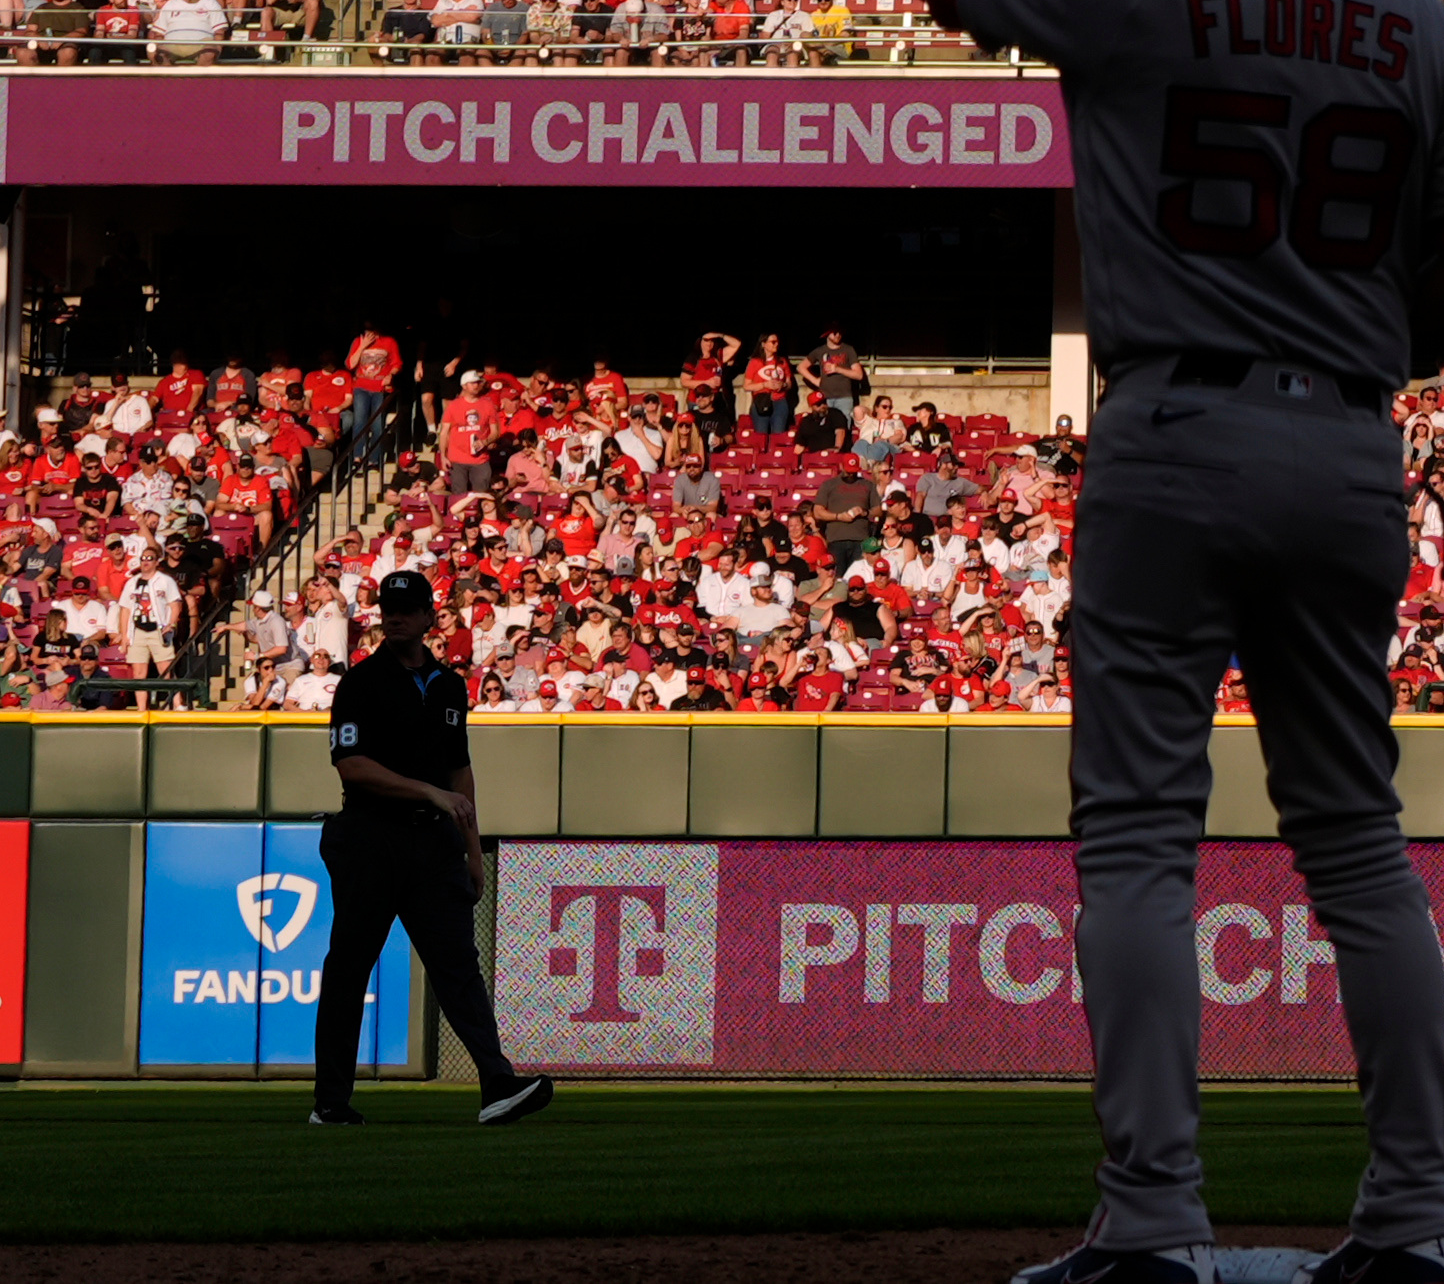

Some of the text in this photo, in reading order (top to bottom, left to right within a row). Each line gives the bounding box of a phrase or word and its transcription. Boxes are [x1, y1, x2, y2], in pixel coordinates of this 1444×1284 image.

[281, 100, 1054, 166] PITCH CHALLENGED
[1158, 85, 1417, 270] 58
[545, 425, 572, 441] Reds
[779, 902, 1083, 1004] PITC
[173, 970, 376, 1004] FANDU
